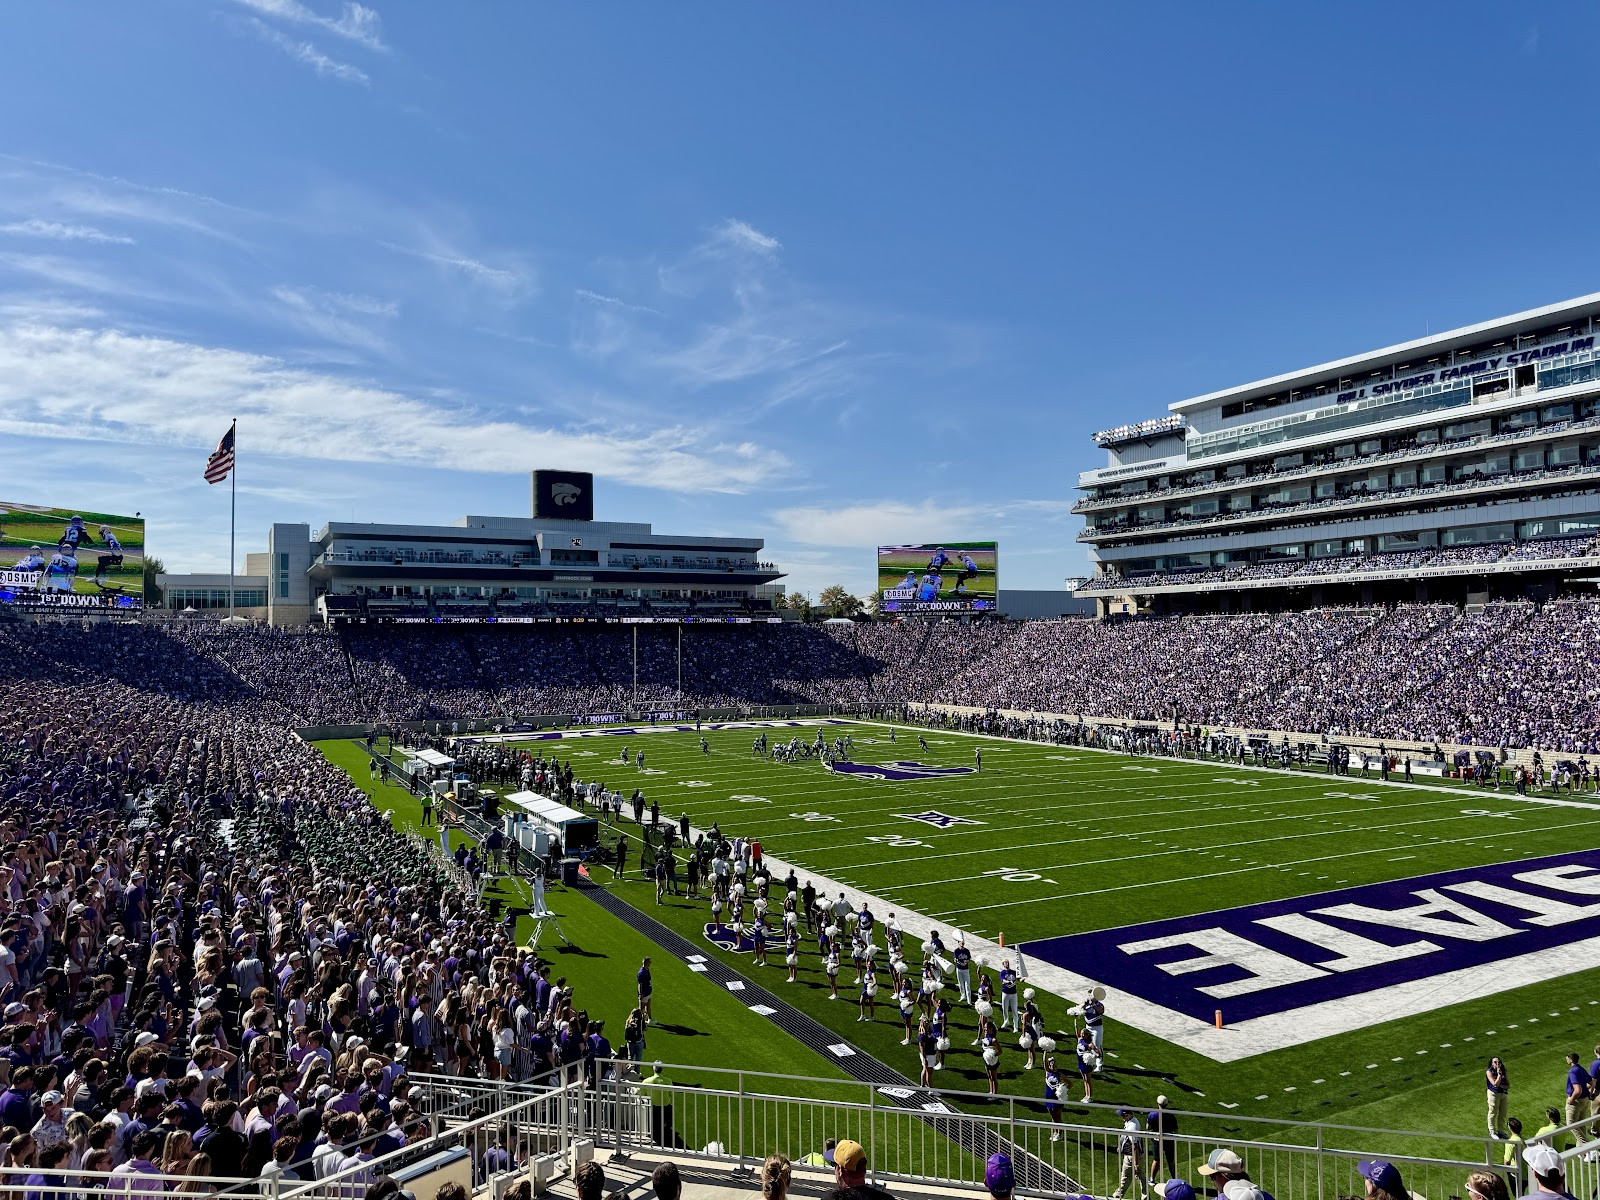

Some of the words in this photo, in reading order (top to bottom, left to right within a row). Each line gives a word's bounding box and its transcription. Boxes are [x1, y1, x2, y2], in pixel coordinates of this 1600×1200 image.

[1337, 389, 1366, 404] BILL
[1372, 374, 1435, 394] SNYDER
[1440, 358, 1502, 382] FAMILY
[1506, 337, 1595, 367] STADIUM
[7, 572, 36, 582] OSMC
[40, 594, 58, 605] 1ST
[60, 595, 100, 606] DOWN
[915, 602, 928, 610] 1ST
[930, 602, 961, 610] DOWN
[981, 866, 1042, 882] 10
